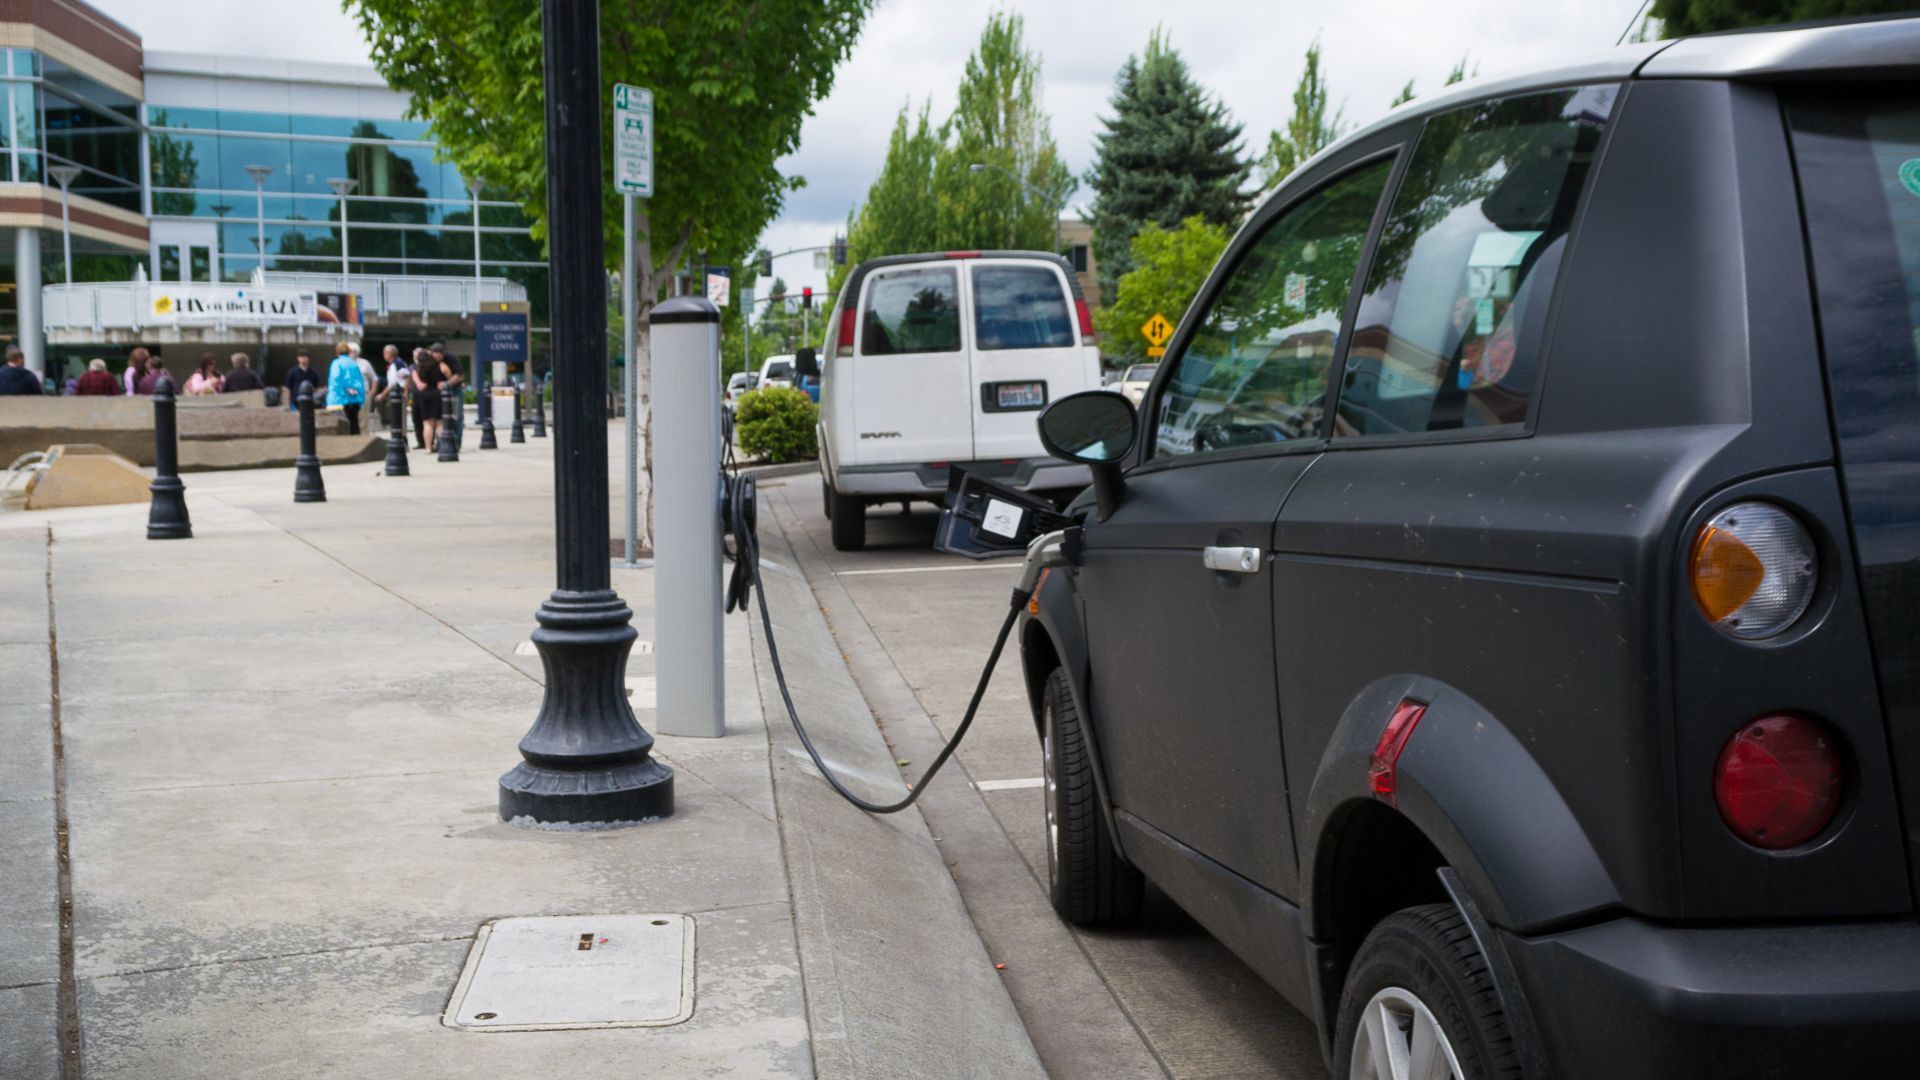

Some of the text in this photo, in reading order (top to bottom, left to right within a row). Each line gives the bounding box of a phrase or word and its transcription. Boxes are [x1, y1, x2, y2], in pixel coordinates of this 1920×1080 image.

[248, 300, 297, 315] PLAZA
[493, 333, 514, 341] CIVIC
[490, 342, 519, 350] CENTER
